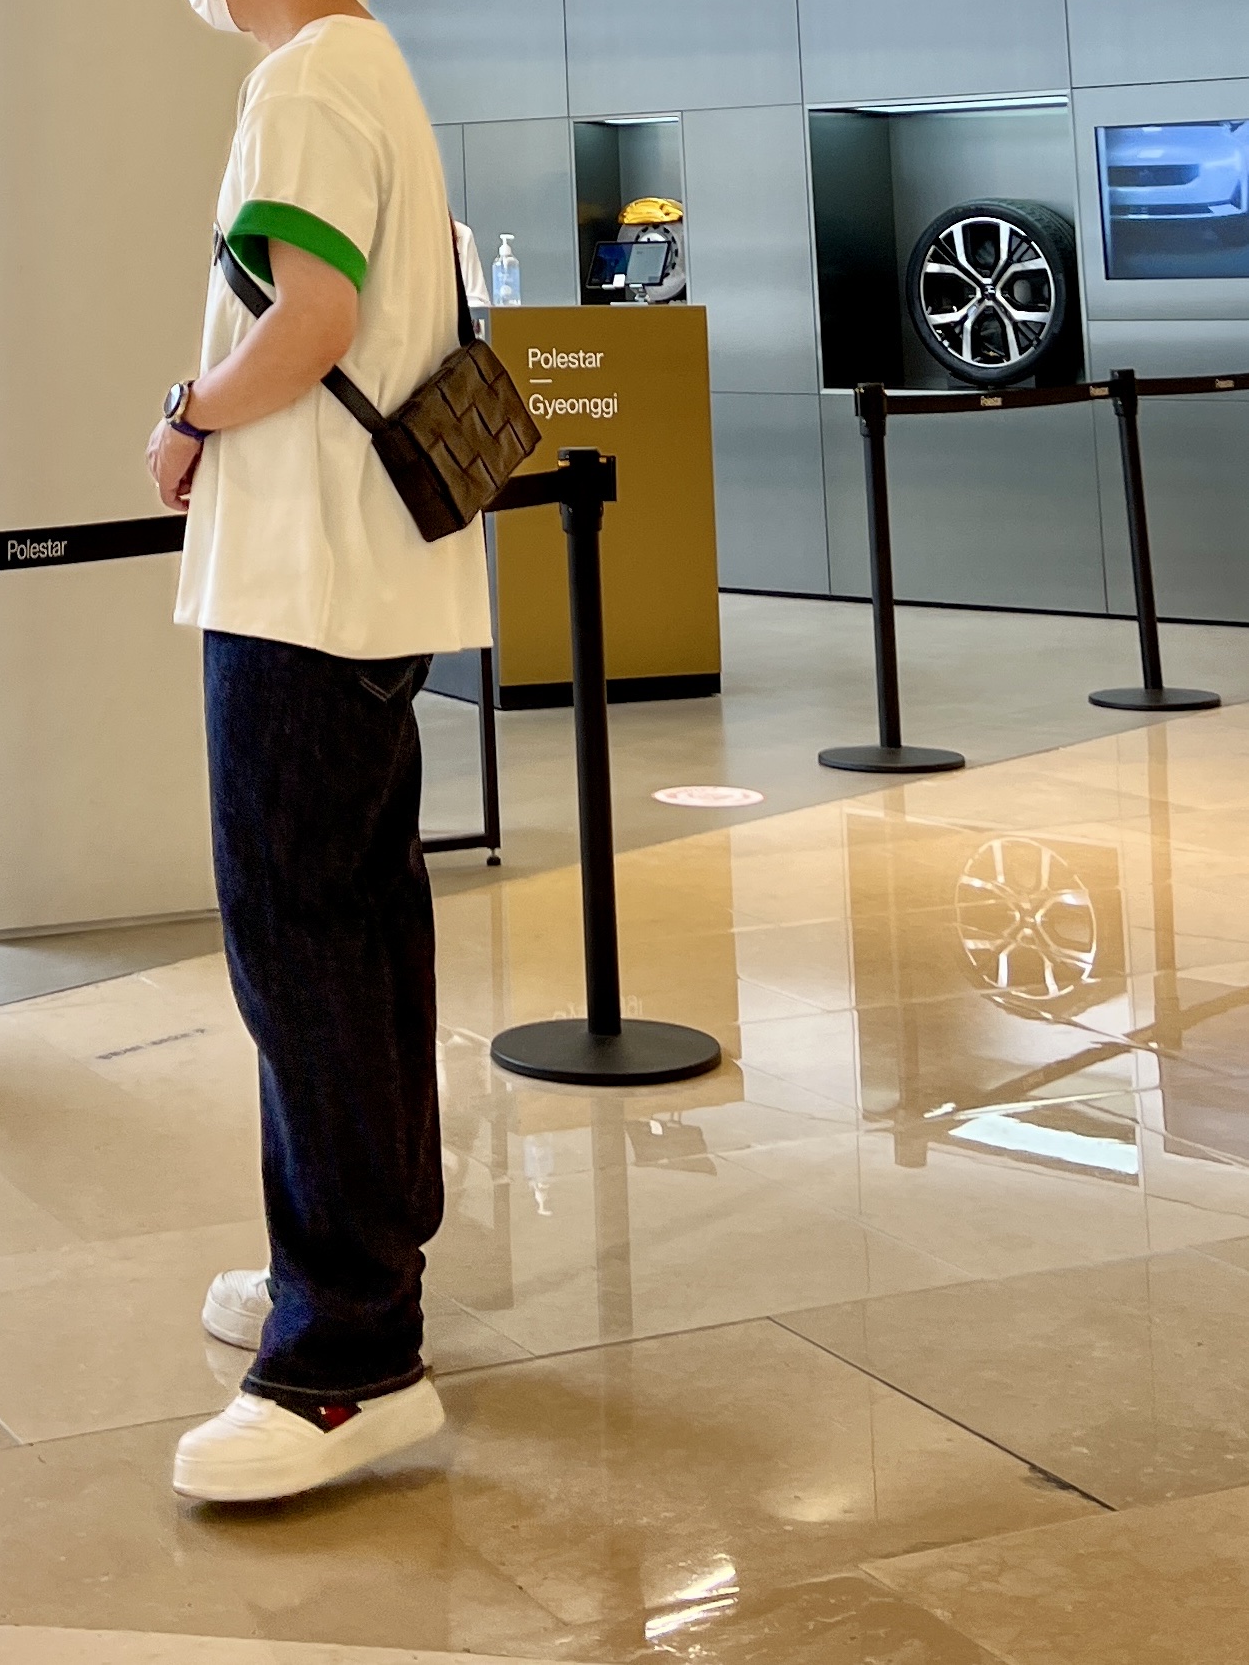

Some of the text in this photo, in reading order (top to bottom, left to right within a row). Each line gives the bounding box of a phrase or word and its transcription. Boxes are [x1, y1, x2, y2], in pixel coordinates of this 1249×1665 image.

[528, 347, 605, 370] Polestar
[528, 392, 619, 420] Gyeonggi
[7, 538, 69, 562] Polestar
